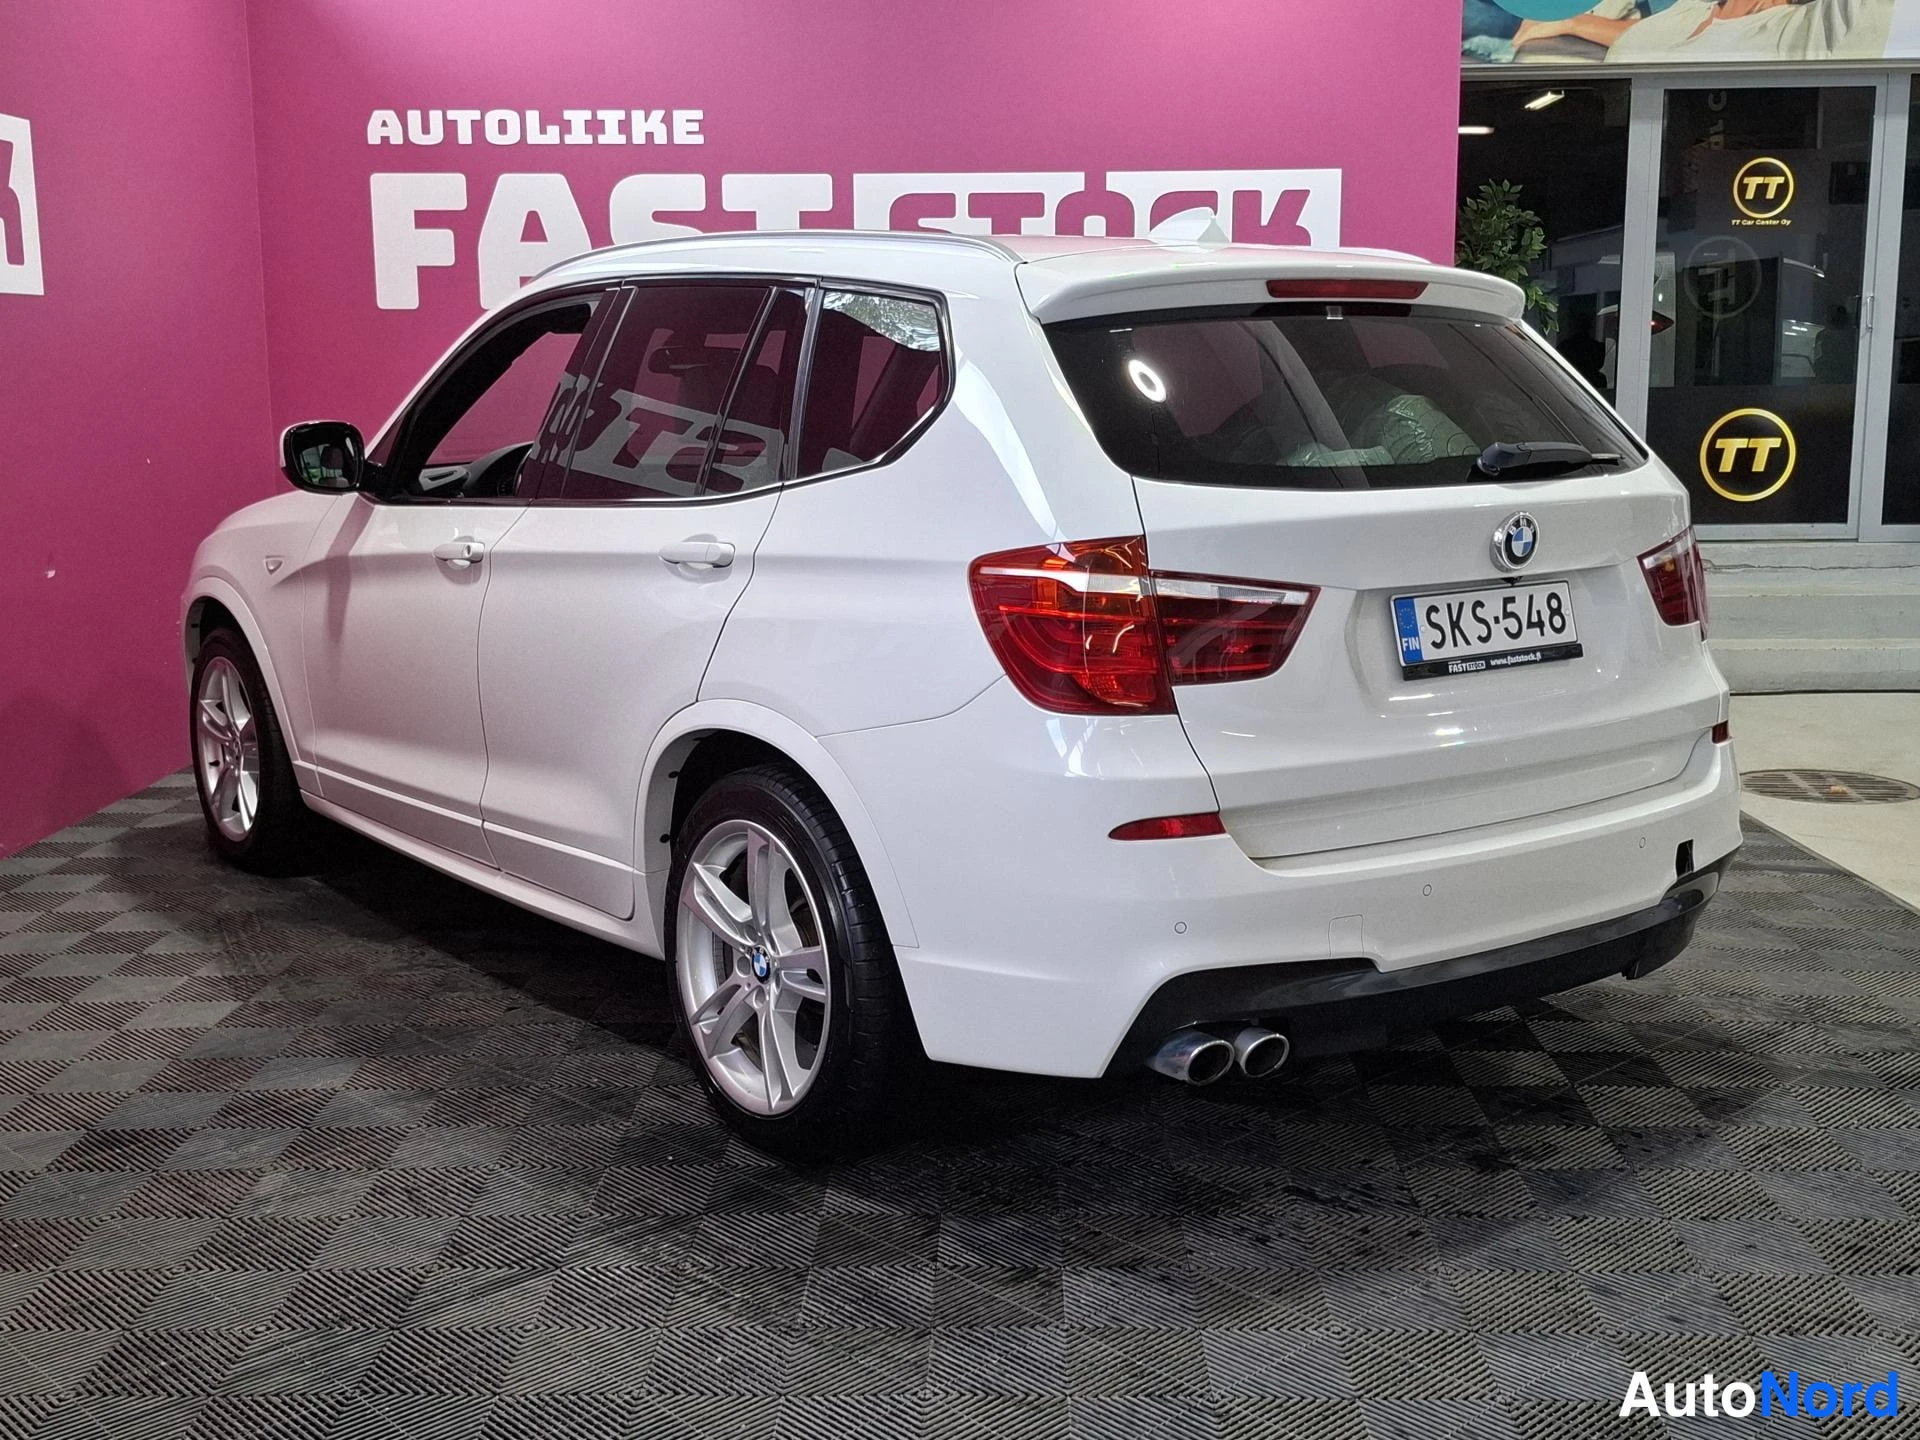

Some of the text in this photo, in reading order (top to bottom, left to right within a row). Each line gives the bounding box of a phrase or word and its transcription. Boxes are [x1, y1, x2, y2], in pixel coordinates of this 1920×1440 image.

[367, 110, 705, 145] AUTOLIIKE
[1743, 176, 1785, 200] TT
[1780, 218, 1792, 227] Oy
[1715, 437, 1782, 473] TT
[1425, 592, 1567, 650] SKS-548
[1402, 636, 1421, 652] FIN
